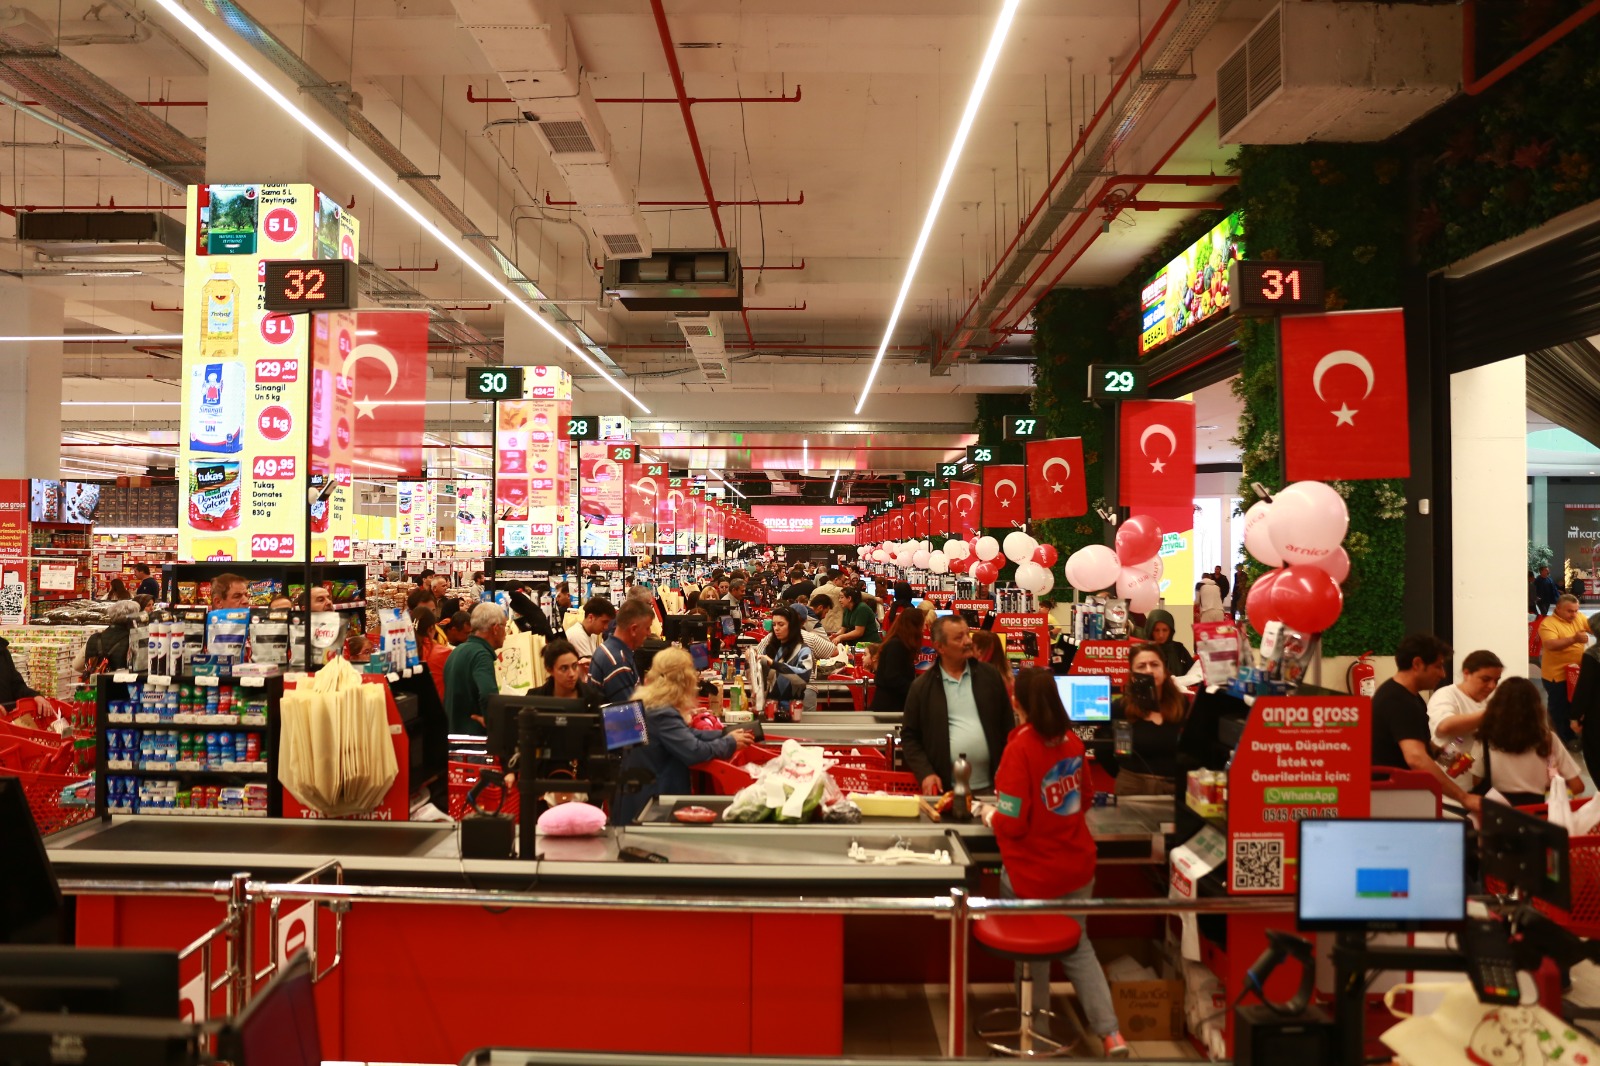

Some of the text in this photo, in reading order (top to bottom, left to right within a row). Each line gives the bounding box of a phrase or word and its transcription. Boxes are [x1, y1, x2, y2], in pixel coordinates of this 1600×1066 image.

[261, 197, 297, 205] Zeytinyağı
[269, 218, 294, 232] 5 L
[285, 269, 325, 299] 32
[1262, 270, 1300, 300] 31
[266, 320, 291, 334] 5 L
[256, 361, 297, 377] 129,90
[479, 373, 507, 393] 30
[1104, 371, 1134, 392] 29
[255, 384, 286, 393] Sinangil
[272, 394, 280, 402] kg
[261, 417, 289, 432] 5 kg
[567, 420, 587, 435] 28
[1015, 419, 1036, 435] 27
[614, 447, 631, 460] 26
[974, 449, 991, 462] 25
[254, 459, 294, 477] 49,95
[648, 466, 663, 476] 24
[942, 466, 956, 476] 23
[198, 471, 224, 482] tukaş
[669, 478, 682, 488] 22
[924, 478, 935, 487] 21
[253, 482, 275, 490] Tukaş
[689, 488, 700, 496] 20
[910, 488, 920, 496] 19
[198, 488, 231, 505] Domates
[10, 502, 26, 510] gross
[884, 500, 893, 508] 15
[266, 510, 271, 518] g
[764, 518, 813, 528] anpa gross
[252, 537, 293, 551] 209,90
[1285, 543, 1329, 556] arnica
[1000, 617, 1044, 626] anpa gross
[1084, 646, 1114, 658] anpa
[1078, 666, 1128, 674] Duygu, Düşün
[1262, 707, 1359, 728] anpa gross
[1252, 740, 1351, 753] Duygu, Düşünce,
[1277, 754, 1324, 767] İstek ve
[1252, 770, 1350, 784] Önerileriniz için;
[1280, 791, 1336, 803] WhatsApp
[1264, 808, 1288, 822] 0545
[1310, 808, 1317, 818] 0
